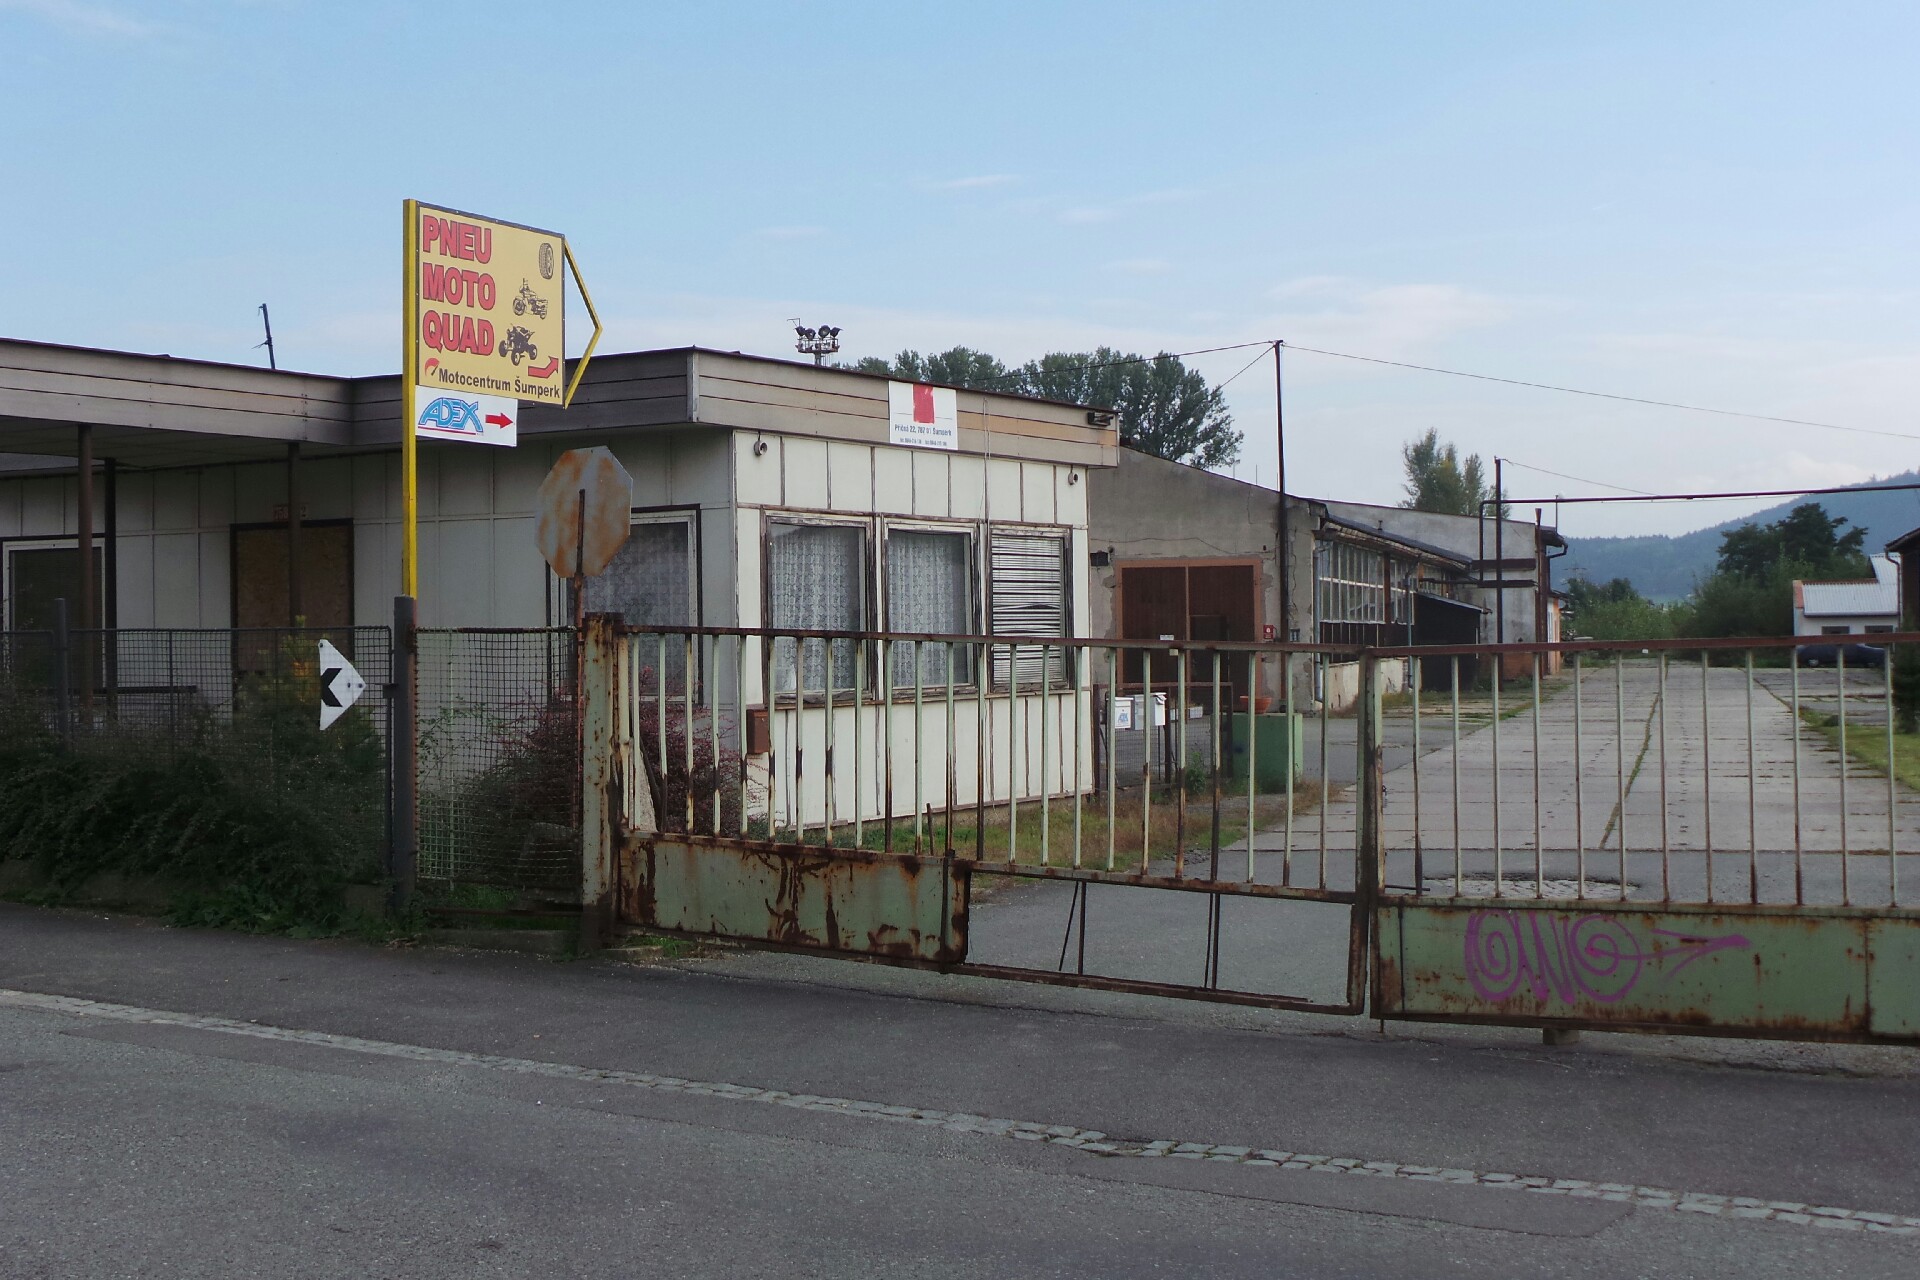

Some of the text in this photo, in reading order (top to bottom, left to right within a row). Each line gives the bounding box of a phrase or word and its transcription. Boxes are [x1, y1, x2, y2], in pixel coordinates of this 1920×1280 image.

[423, 214, 491, 264] PNEU
[423, 262, 496, 310] MOTO
[423, 310, 494, 356] QUAD
[439, 368, 560, 399] Motocentrum Šumperk
[418, 397, 483, 432] ADEX
